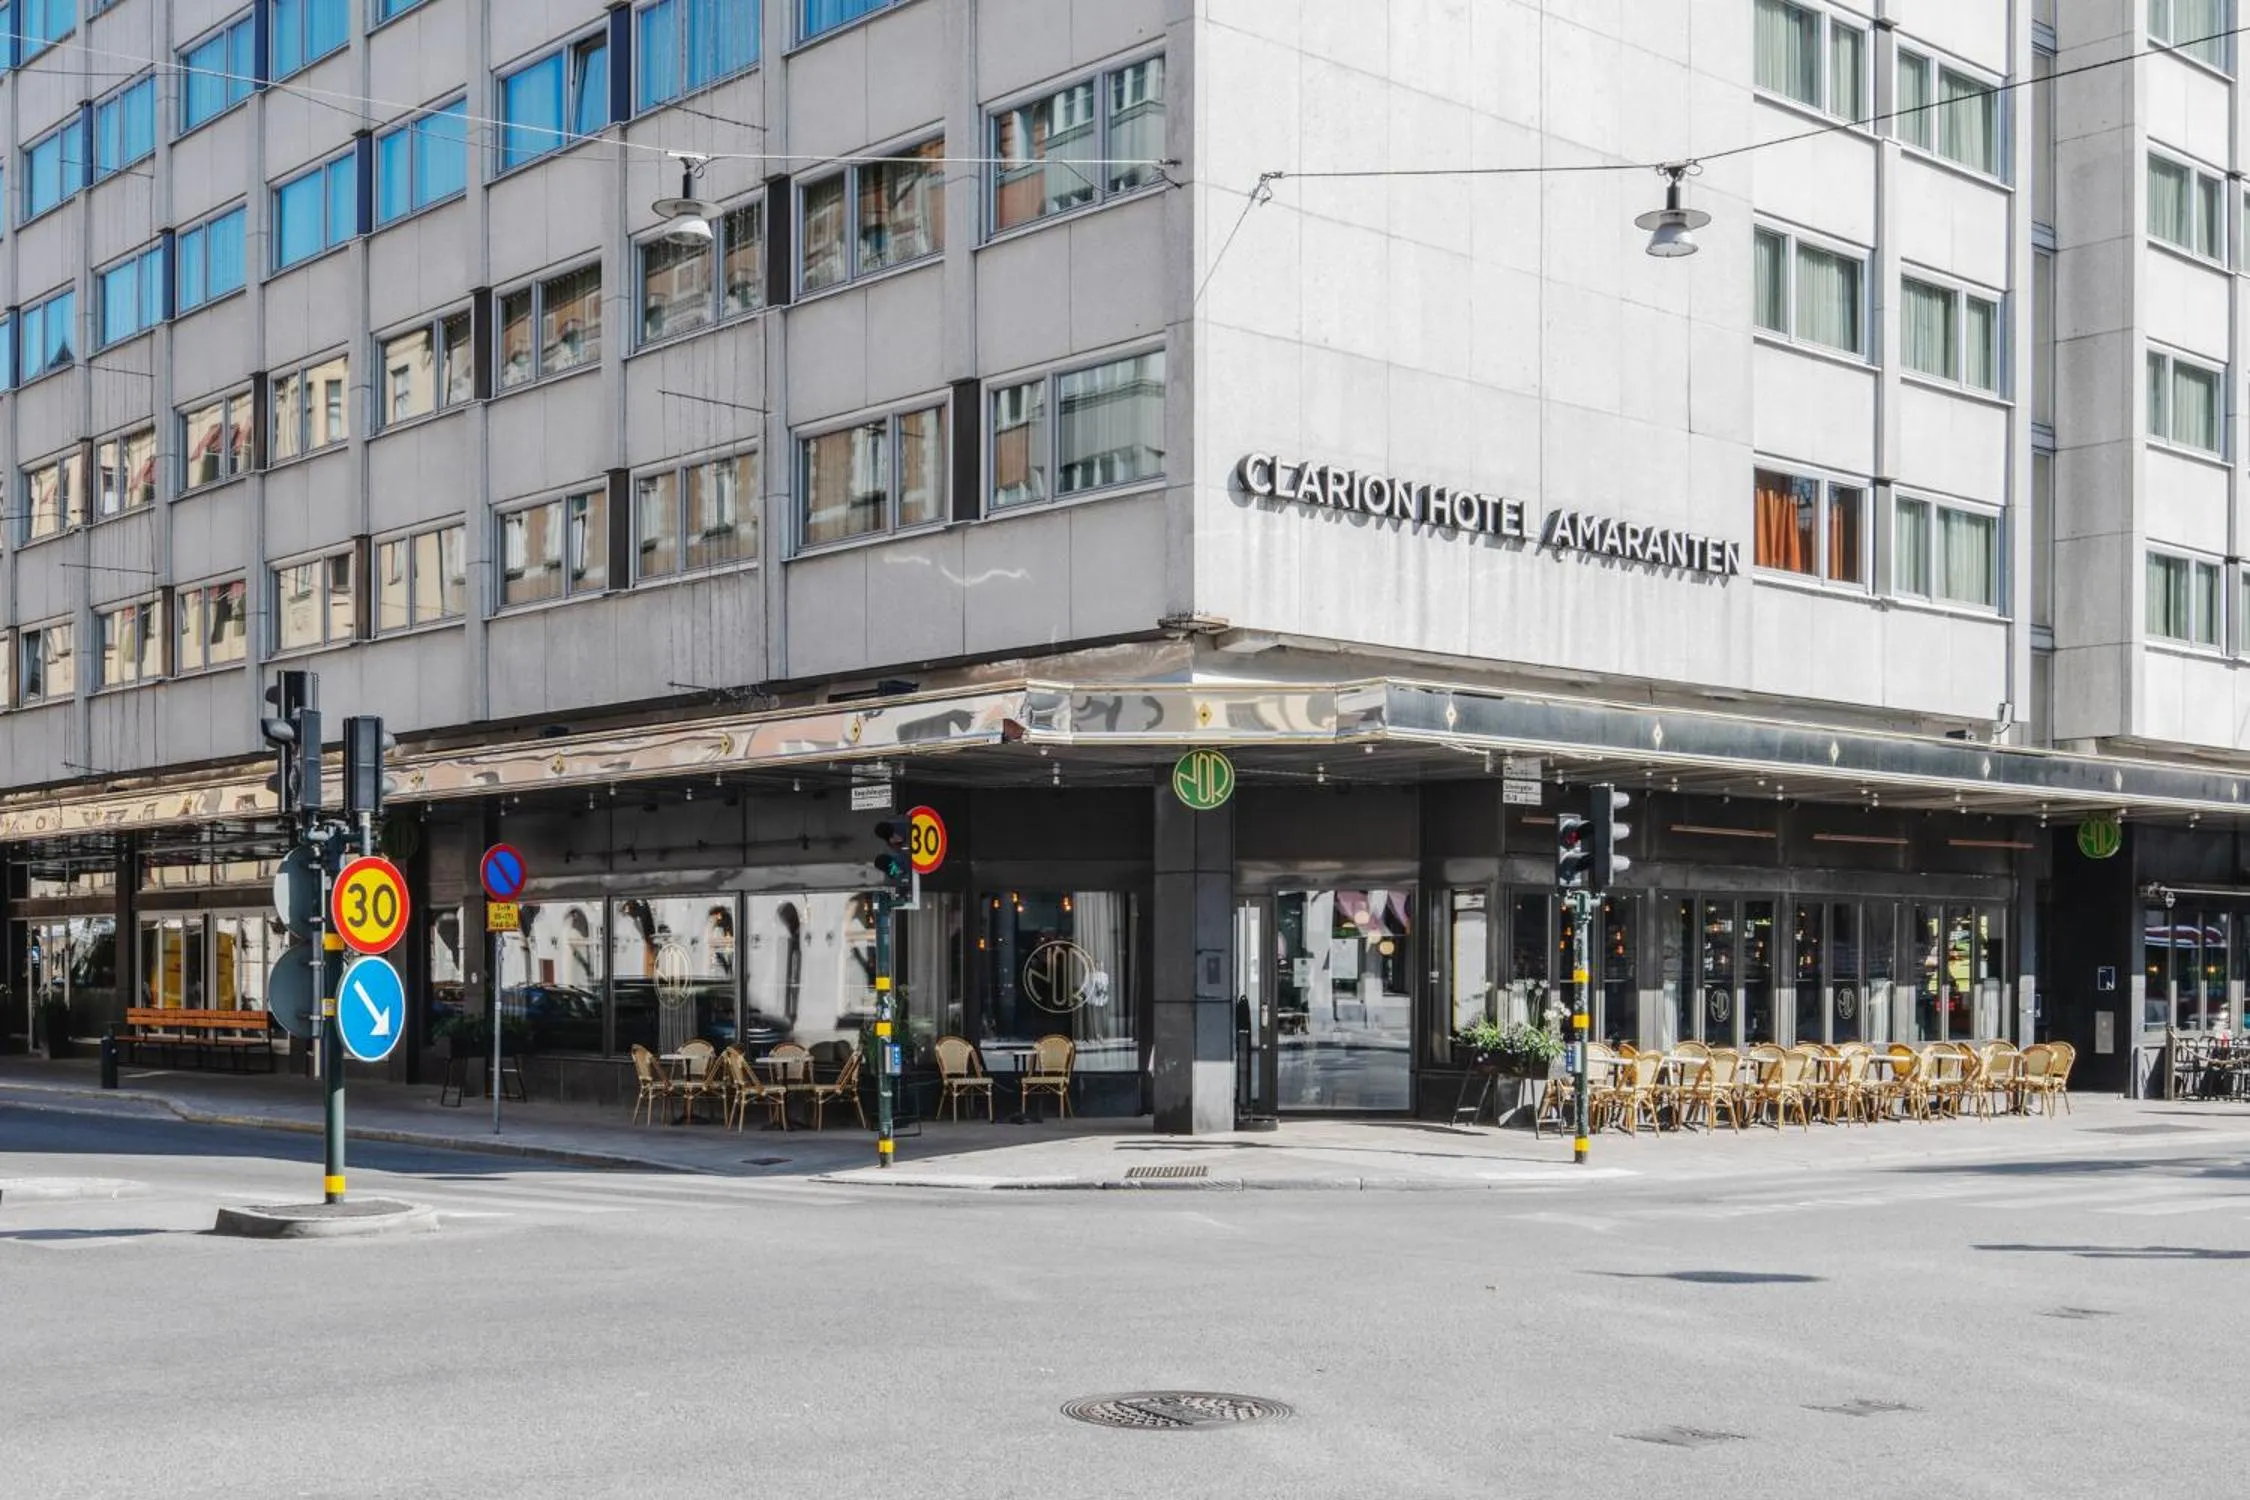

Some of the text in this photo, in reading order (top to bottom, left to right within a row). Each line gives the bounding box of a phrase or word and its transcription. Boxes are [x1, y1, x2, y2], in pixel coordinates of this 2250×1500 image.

[1240, 451, 1740, 576] CLARION HOTEL AMARANTEN
[912, 824, 939, 856] 30
[347, 882, 398, 929] 30
